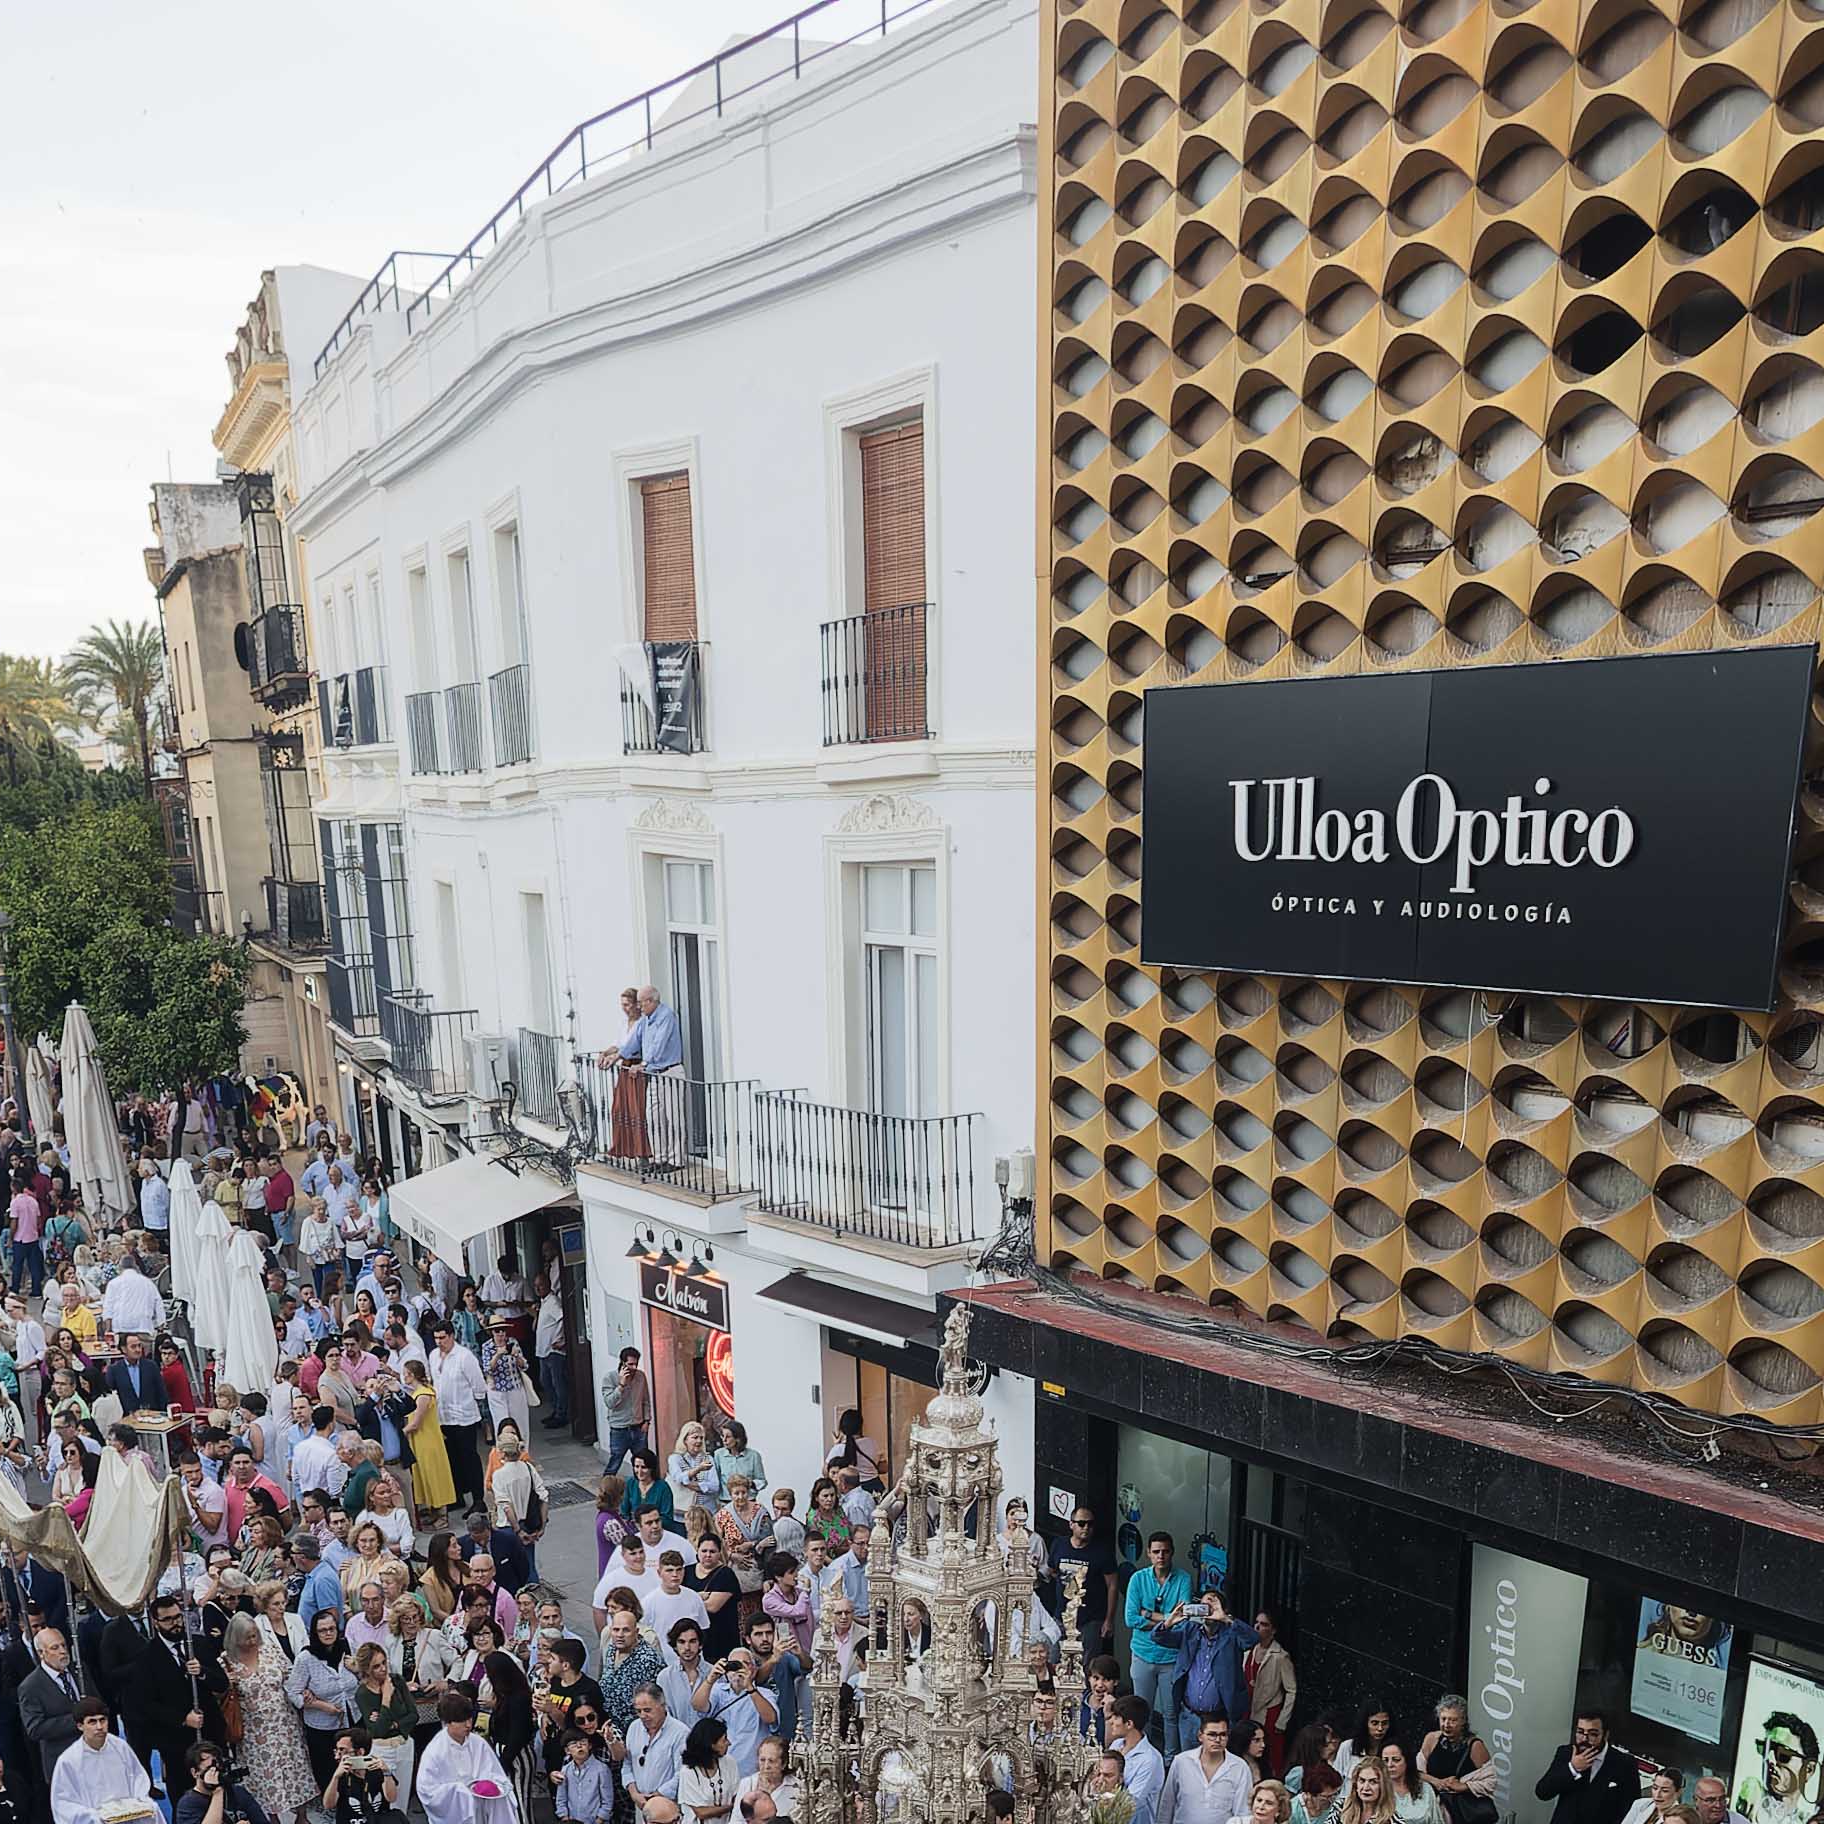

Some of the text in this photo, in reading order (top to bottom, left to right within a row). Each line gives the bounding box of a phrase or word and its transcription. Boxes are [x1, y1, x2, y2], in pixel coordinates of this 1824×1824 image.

[1228, 773, 1634, 894] Ulloa Optico
[1271, 892, 1572, 924] ÓPTICA Y AUDIOLOGÍA
[655, 1269, 710, 1314] Malvón
[1481, 1578, 1525, 1720] Optico
[1652, 1633, 1719, 1667] GUESS
[1679, 1682, 1718, 1707] 139€
